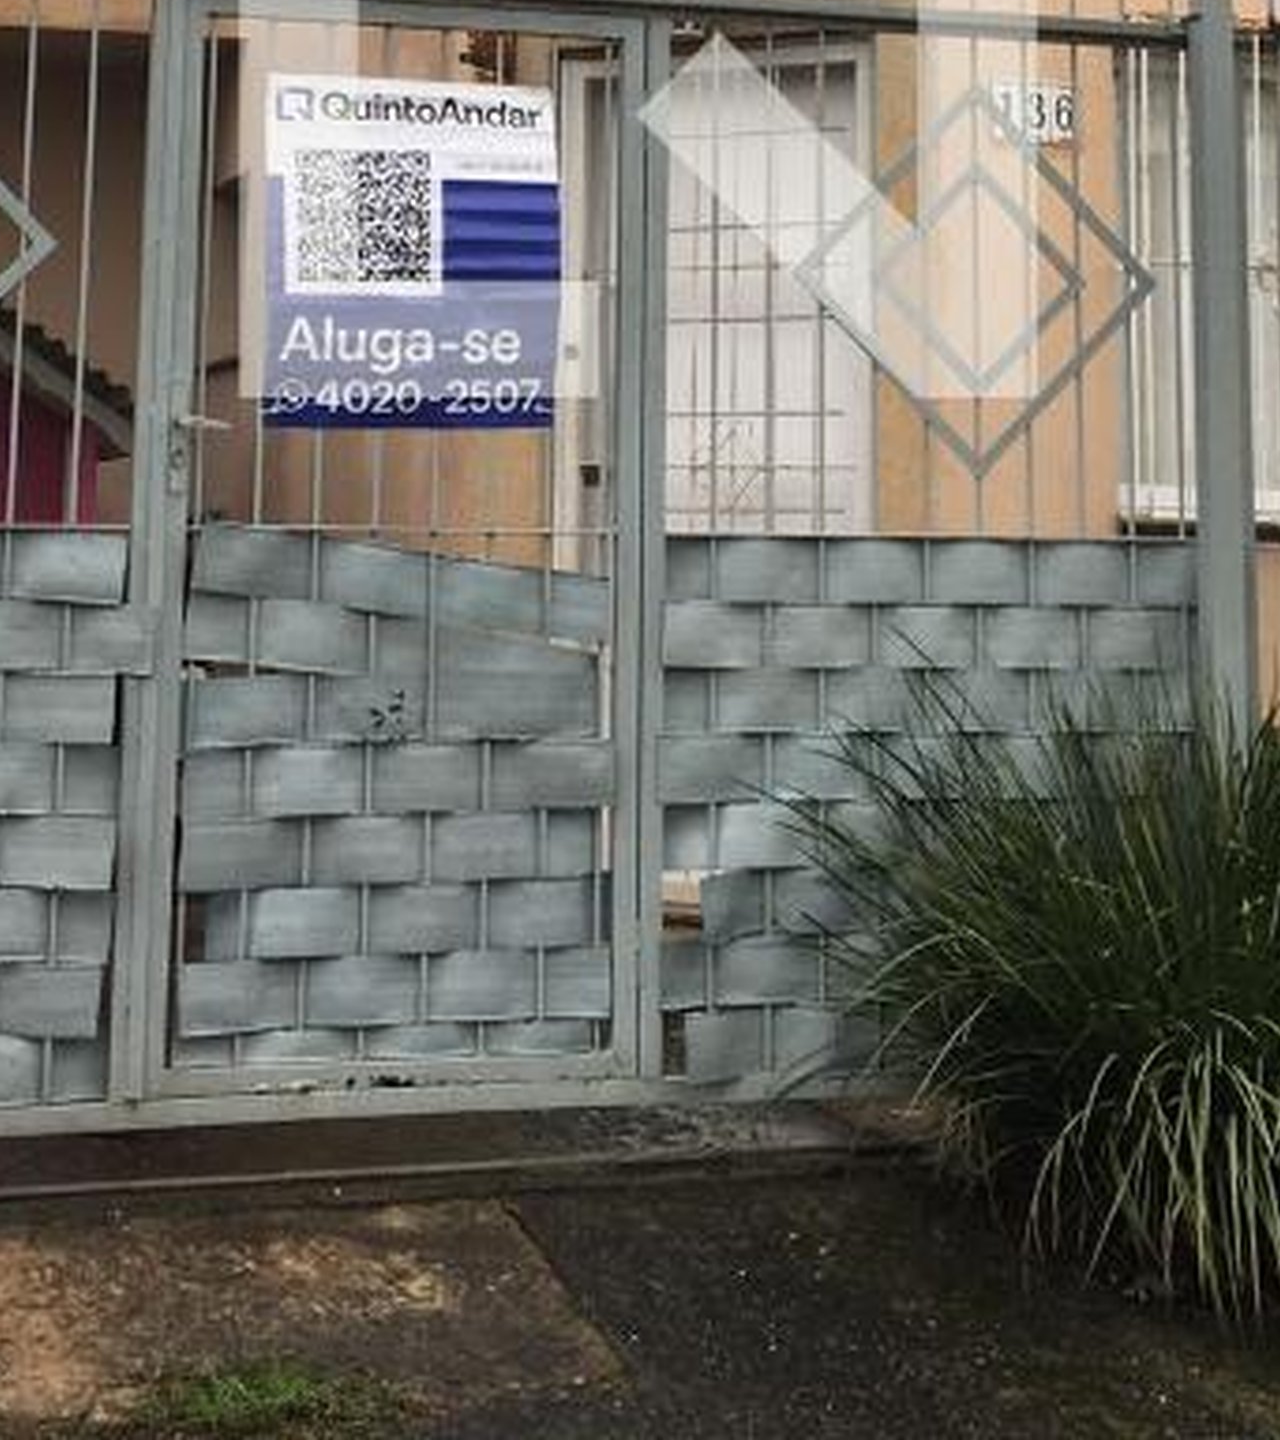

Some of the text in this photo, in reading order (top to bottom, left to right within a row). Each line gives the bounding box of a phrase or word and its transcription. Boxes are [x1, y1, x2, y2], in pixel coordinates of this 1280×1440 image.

[321, 89, 542, 130] QuintoAndar
[999, 89, 1074, 131] 136
[279, 316, 522, 374] Aluga-se
